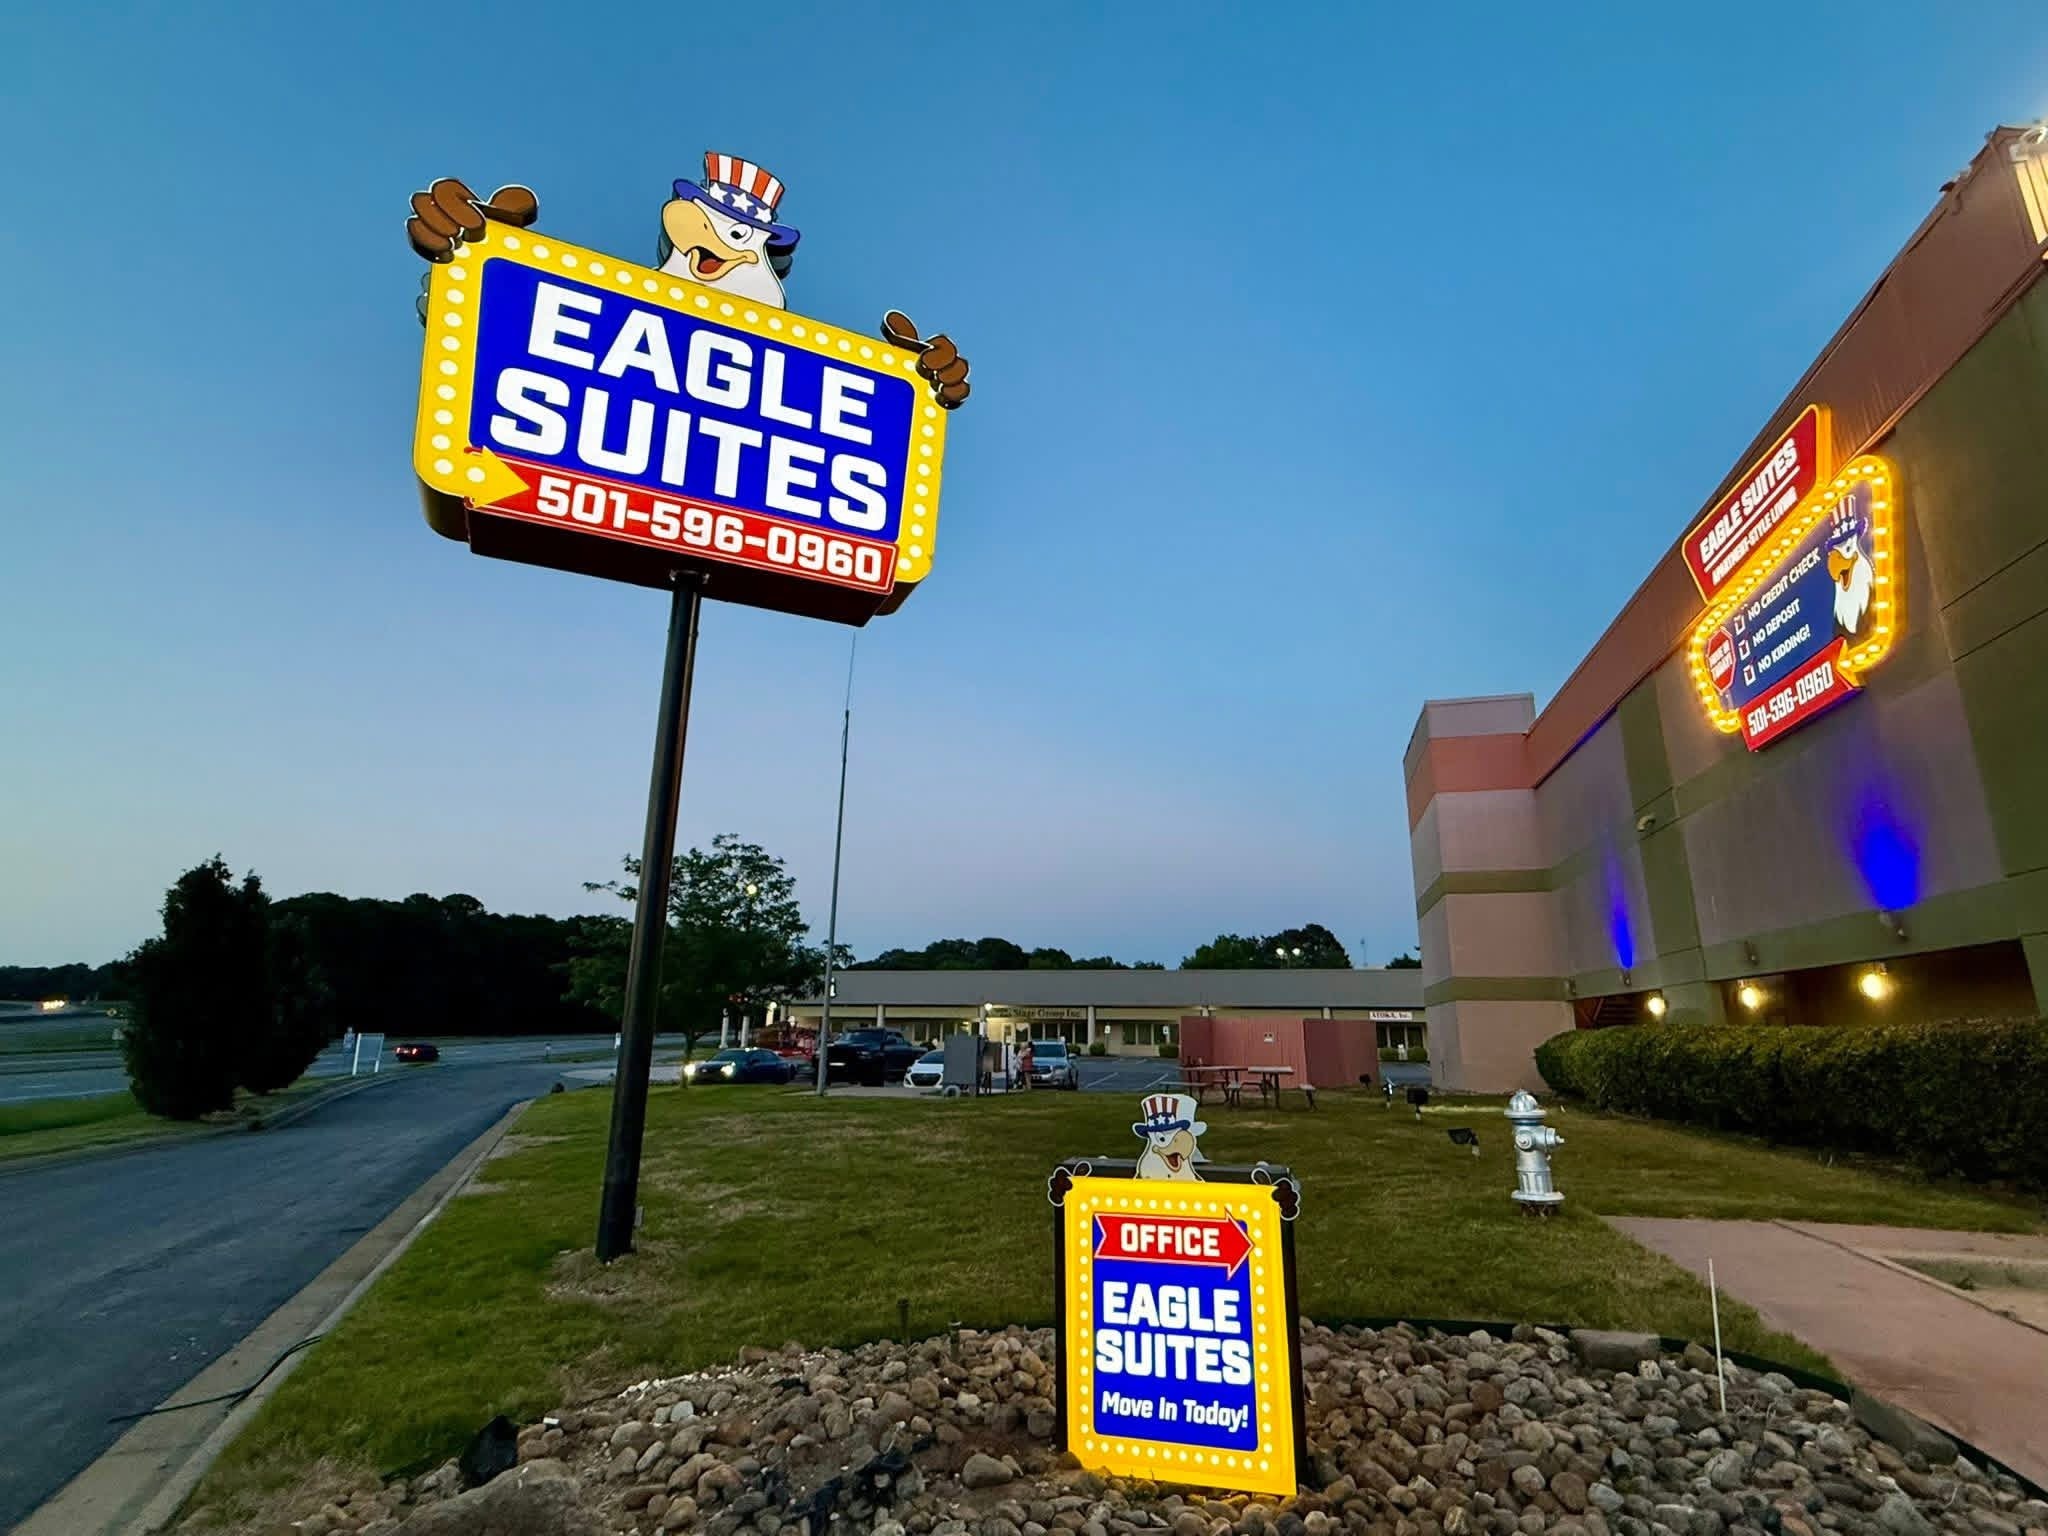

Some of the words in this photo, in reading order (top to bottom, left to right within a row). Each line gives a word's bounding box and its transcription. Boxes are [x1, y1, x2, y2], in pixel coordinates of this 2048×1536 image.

[527, 281, 876, 445] EAGLE
[489, 367, 888, 531] SUITES
[537, 475, 882, 583] 501-596-0960
[1699, 500, 1743, 564] EAGLE
[1741, 437, 1798, 516] SUITES
[1747, 601, 1761, 621] NO
[1761, 575, 1789, 609] CREDIT
[1789, 547, 1821, 583] CHECK
[1752, 630, 1766, 647] NO
[1765, 598, 1800, 636] DEPOSIT
[1757, 655, 1771, 673] NO
[1771, 623, 1811, 663] KIDDING!
[1747, 660, 1835, 737] 501-596-0960
[1120, 1222, 1221, 1258] OFFICE
[1102, 1280, 1242, 1335] EAGLE
[1095, 1328, 1253, 1386] SUITES
[1101, 1390, 1154, 1418] Move
[1159, 1397, 1178, 1422] In
[1183, 1398, 1249, 1434] Today!
